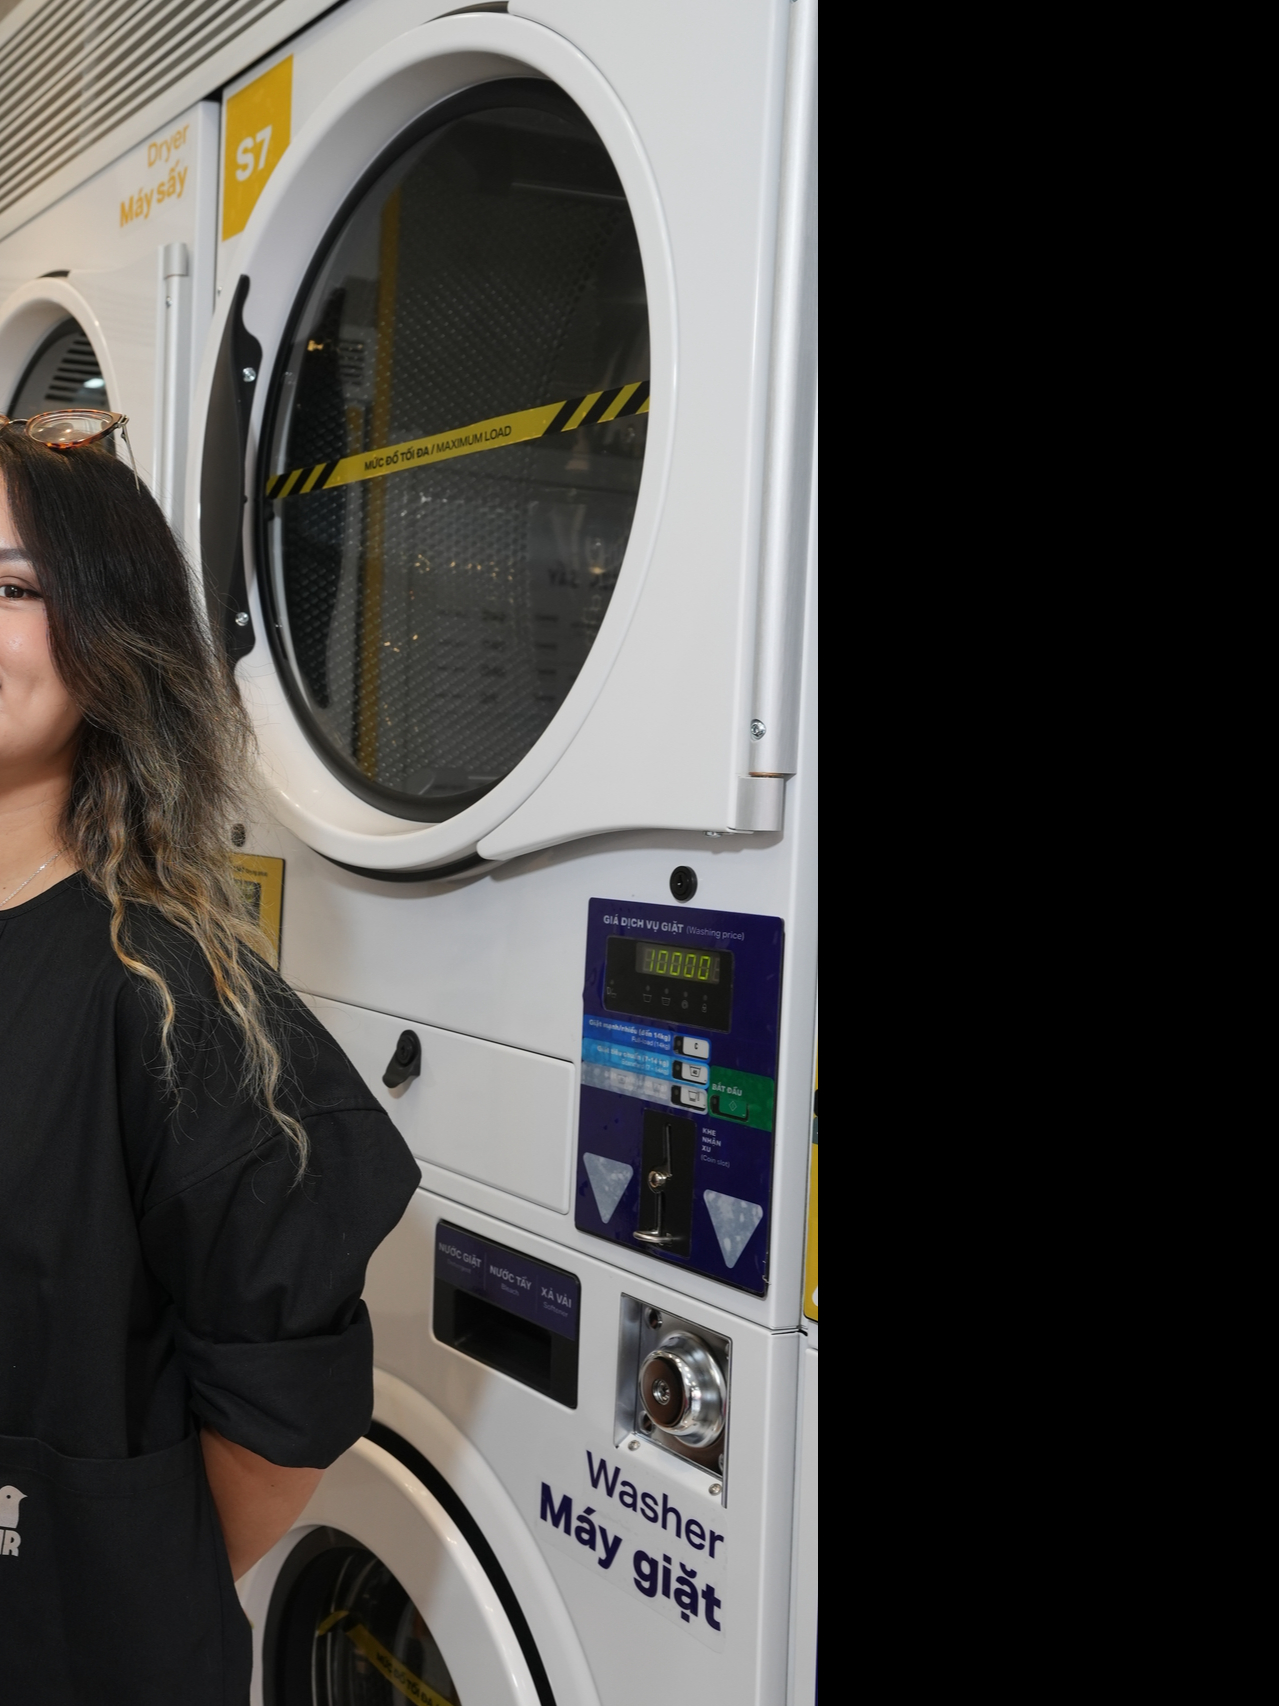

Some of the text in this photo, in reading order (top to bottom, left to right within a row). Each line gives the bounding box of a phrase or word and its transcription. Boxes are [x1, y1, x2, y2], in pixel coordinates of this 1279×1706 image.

[148, 124, 189, 168] Dryer
[235, 124, 272, 182] S7
[120, 188, 154, 228] Máy
[436, 433, 483, 453] MAXIMUM
[484, 425, 512, 441] LOAD
[603, 914, 619, 925] GIÁ
[621, 917, 644, 929] DỊCH
[646, 920, 660, 933] VỤ
[686, 925, 721, 941] (Washing
[722, 931, 745, 942] price)
[649, 950, 711, 980] 10000
[702, 1127, 716, 1136] KHE
[586, 1449, 725, 1559] Washer
[540, 1481, 722, 1632] Máy giặt
